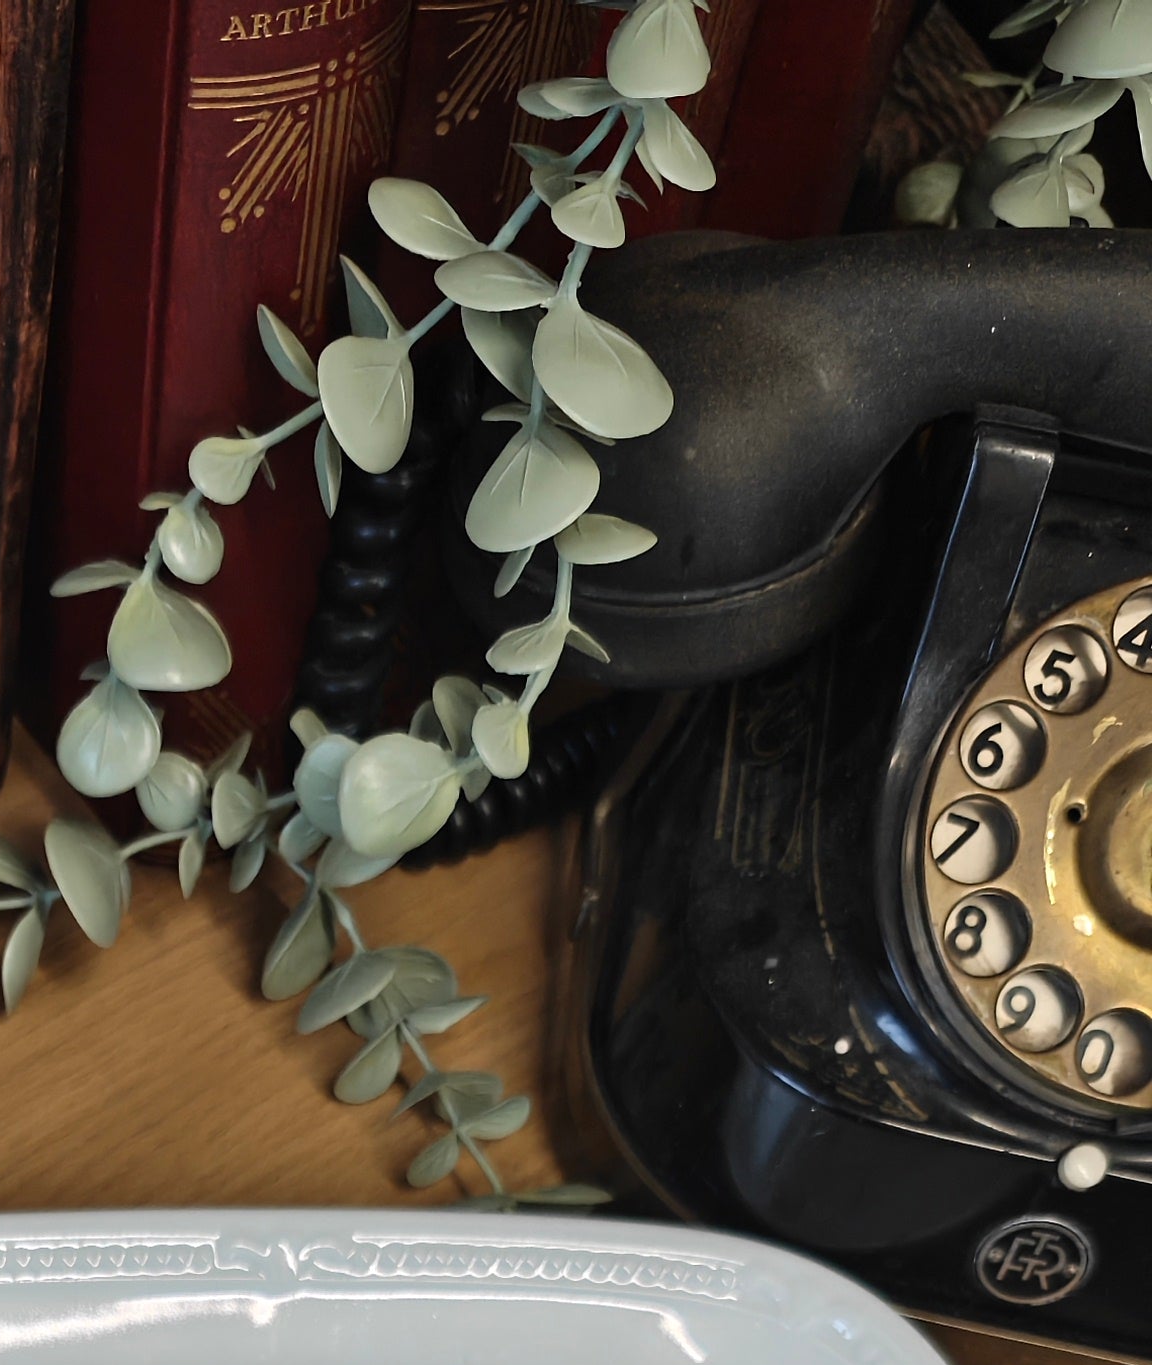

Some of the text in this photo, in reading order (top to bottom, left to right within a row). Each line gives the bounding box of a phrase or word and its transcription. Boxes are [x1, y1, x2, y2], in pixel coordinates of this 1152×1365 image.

[1117, 613, 1152, 669] 4
[1033, 649, 1077, 705] 5
[968, 722, 1004, 777] 6
[935, 812, 980, 866] 7
[947, 905, 987, 958] 8
[999, 986, 1036, 1034] 9
[1077, 1029, 1114, 1082] 0
